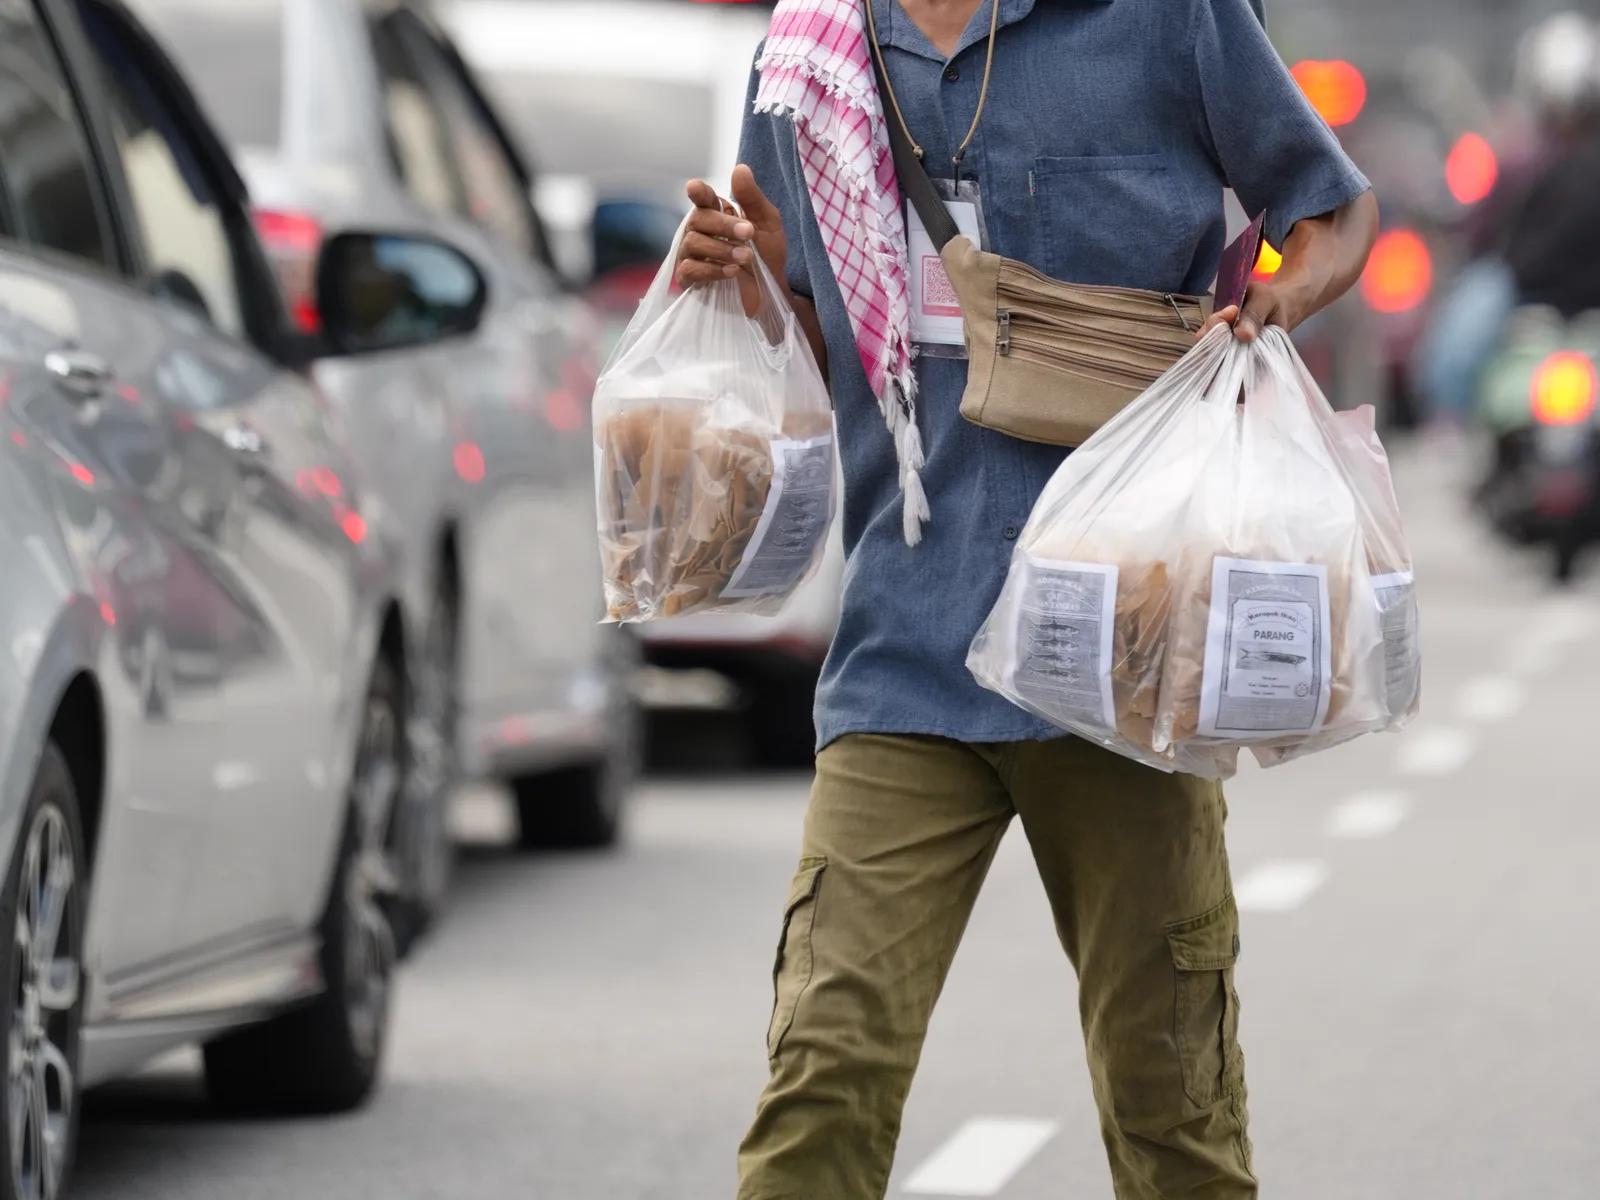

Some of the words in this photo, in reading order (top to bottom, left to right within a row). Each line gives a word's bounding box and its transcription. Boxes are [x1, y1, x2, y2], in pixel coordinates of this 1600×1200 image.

[1248, 611, 1279, 620] Keropok
[1280, 611, 1297, 623] Ikan
[1253, 630, 1294, 641] PARANG
